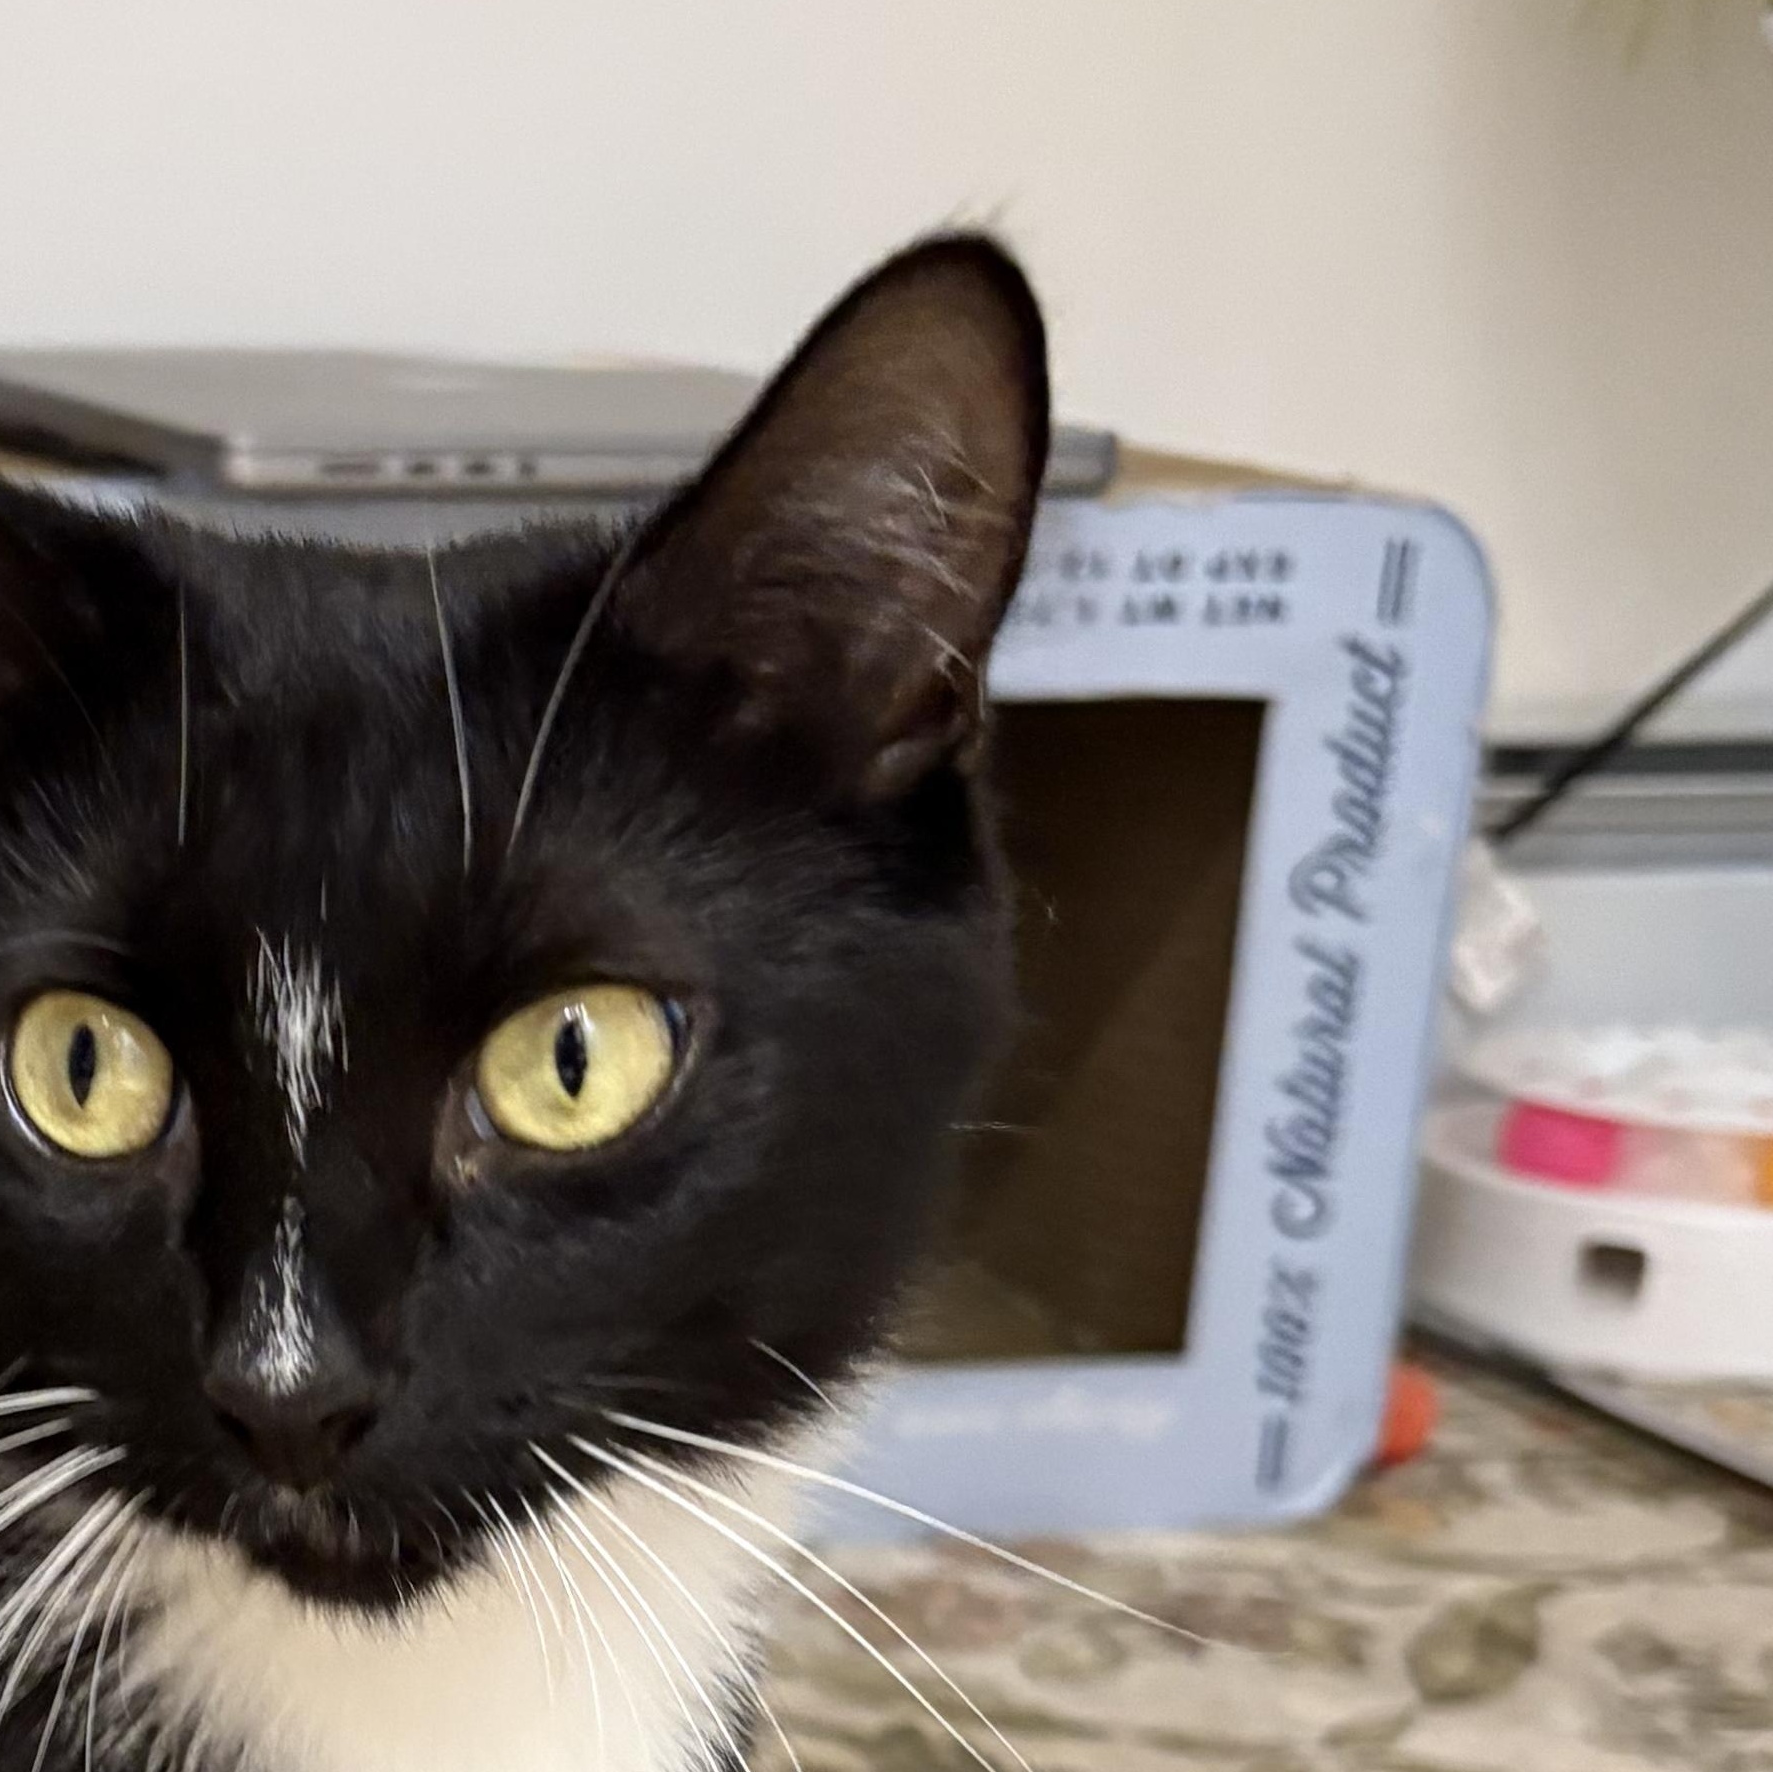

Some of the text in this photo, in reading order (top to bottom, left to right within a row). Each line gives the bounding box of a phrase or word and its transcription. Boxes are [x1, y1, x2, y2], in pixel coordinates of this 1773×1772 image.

[1256, 634, 1407, 1406] 100% Natural Product
